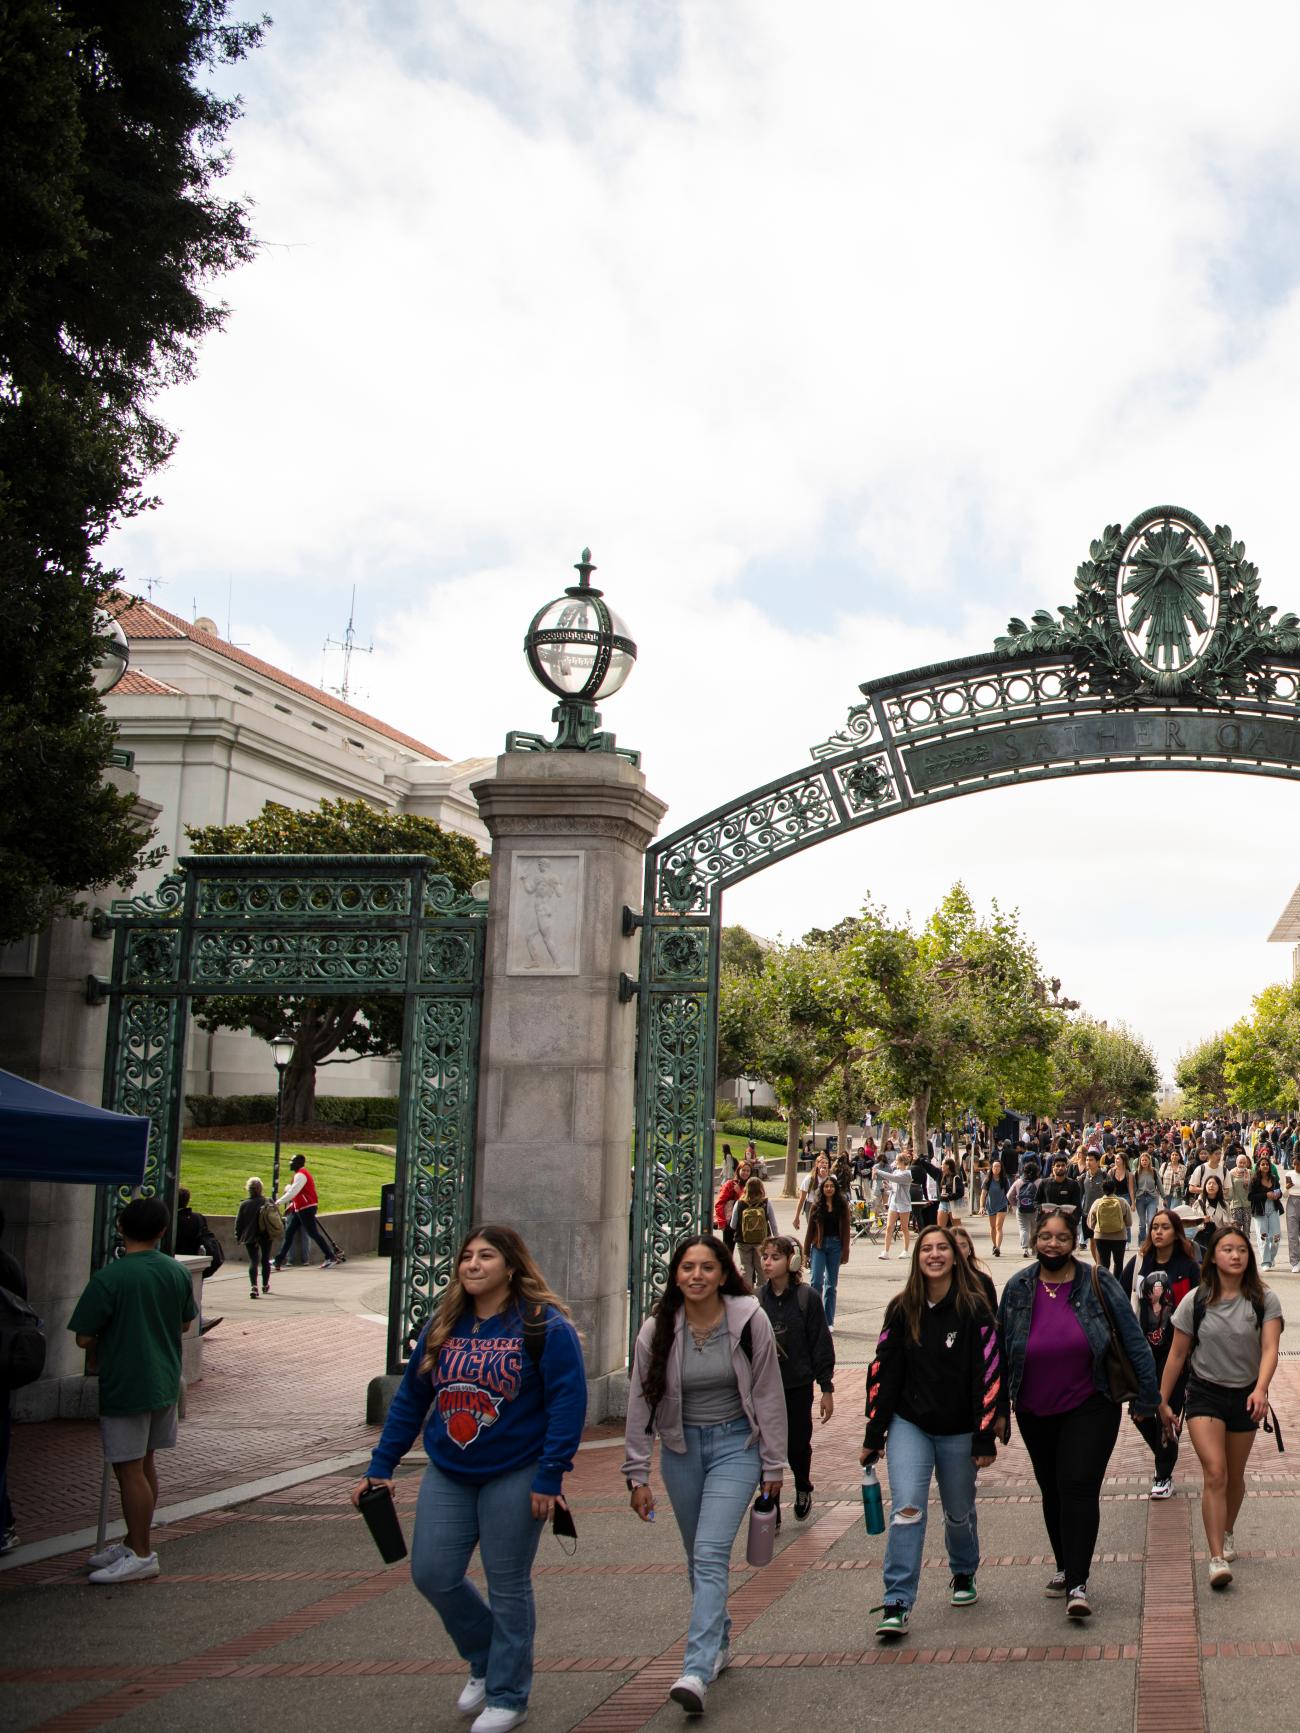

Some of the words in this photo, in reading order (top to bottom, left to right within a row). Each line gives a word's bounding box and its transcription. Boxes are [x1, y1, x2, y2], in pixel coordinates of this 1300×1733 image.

[1005, 719, 1186, 761] SATHER
[441, 1338, 470, 1350] EW
[470, 1338, 524, 1351] YORK
[433, 1350, 522, 1401] NICKS
[440, 1391, 498, 1419] KNICKS
